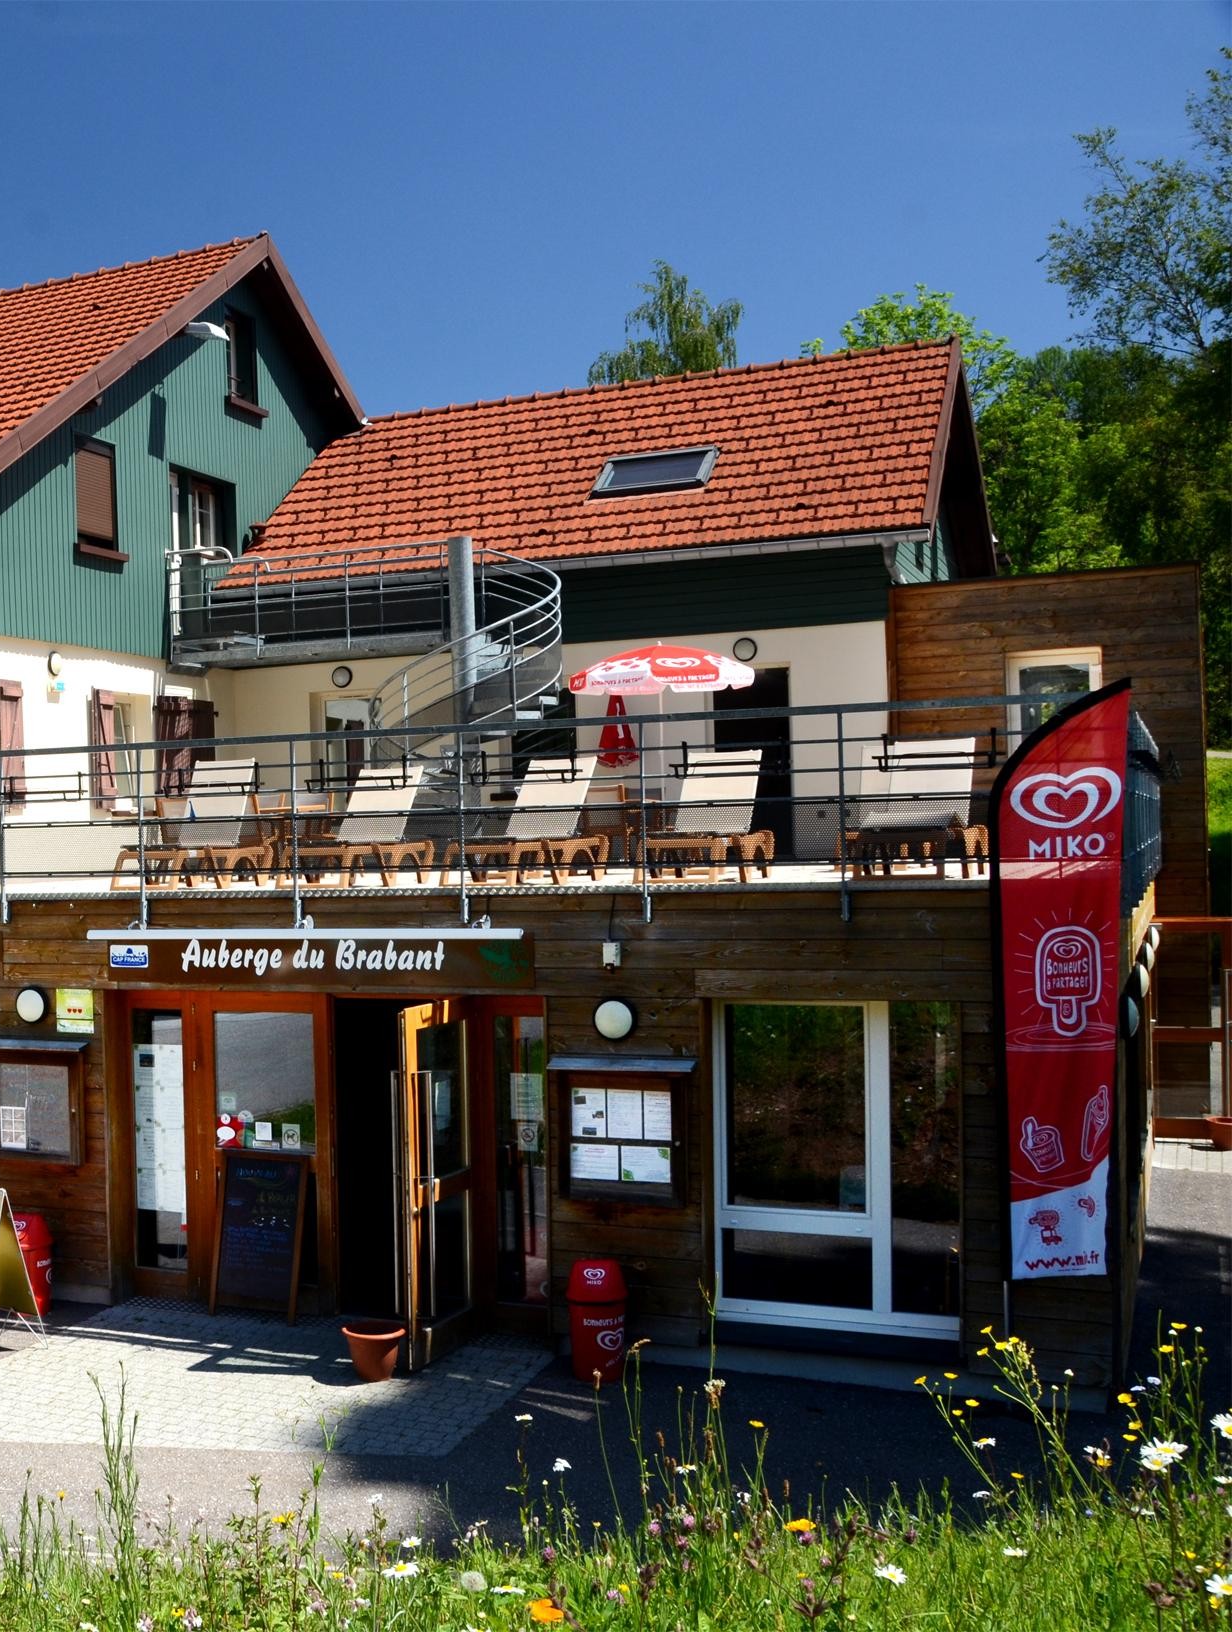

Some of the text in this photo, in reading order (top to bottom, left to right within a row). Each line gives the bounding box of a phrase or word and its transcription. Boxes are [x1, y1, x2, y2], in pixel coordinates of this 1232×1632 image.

[1028, 832, 1106, 861] MIKO
[181, 938, 446, 976] Auberge du Brabant
